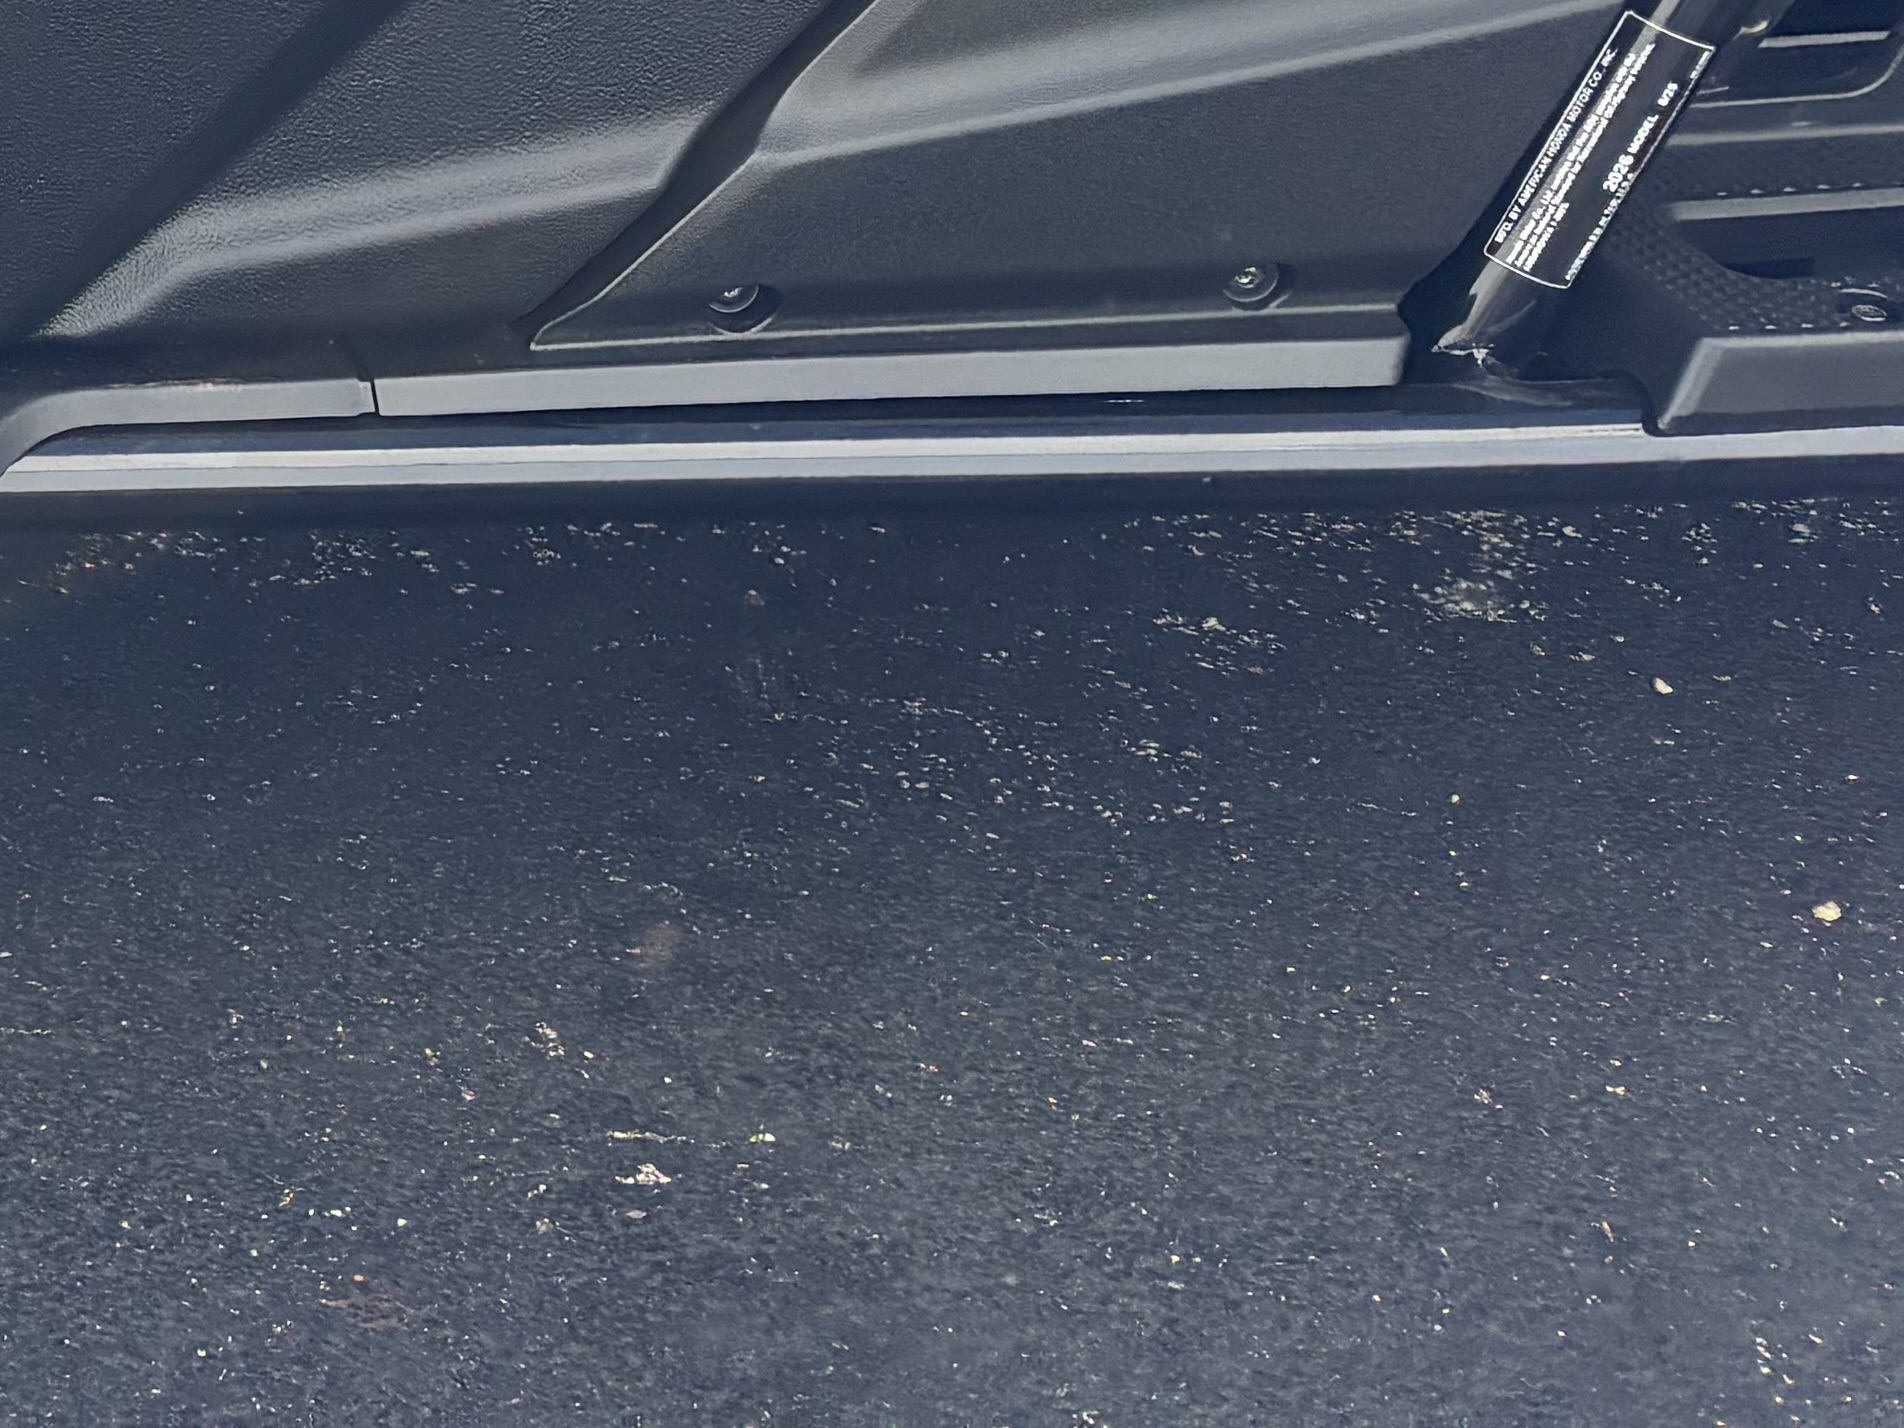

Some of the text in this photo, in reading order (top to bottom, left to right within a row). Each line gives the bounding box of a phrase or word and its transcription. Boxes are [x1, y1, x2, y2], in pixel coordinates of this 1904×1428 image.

[1518, 156, 1552, 205] AMERICAN
[1547, 123, 1572, 158] HONDA
[1568, 87, 1594, 122] MOTOR
[1602, 154, 1635, 193] 2026
[1627, 114, 1659, 154] MODEL
